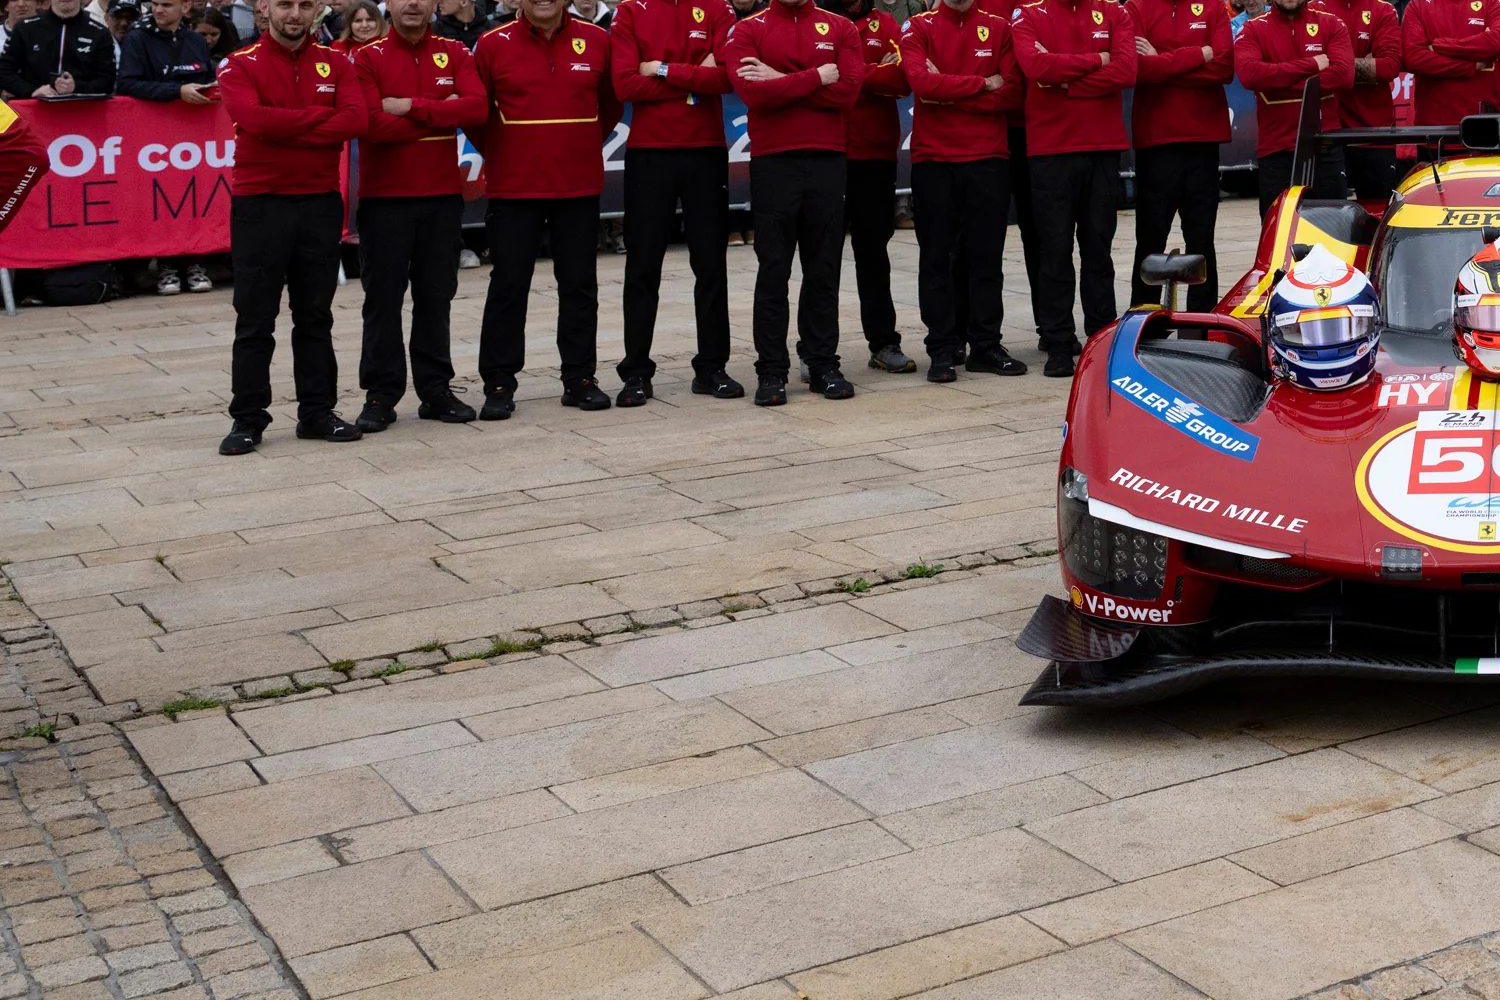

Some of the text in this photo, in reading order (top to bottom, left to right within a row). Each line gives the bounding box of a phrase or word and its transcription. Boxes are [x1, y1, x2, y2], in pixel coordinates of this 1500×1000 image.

[46, 133, 123, 178] Of
[13, 165, 38, 195] MILLE
[46, 180, 119, 229] LE
[1112, 375, 1250, 452] ADLER GROUP
[1377, 382, 1441, 407] HY
[1109, 467, 1309, 533] RICHARD MILLE
